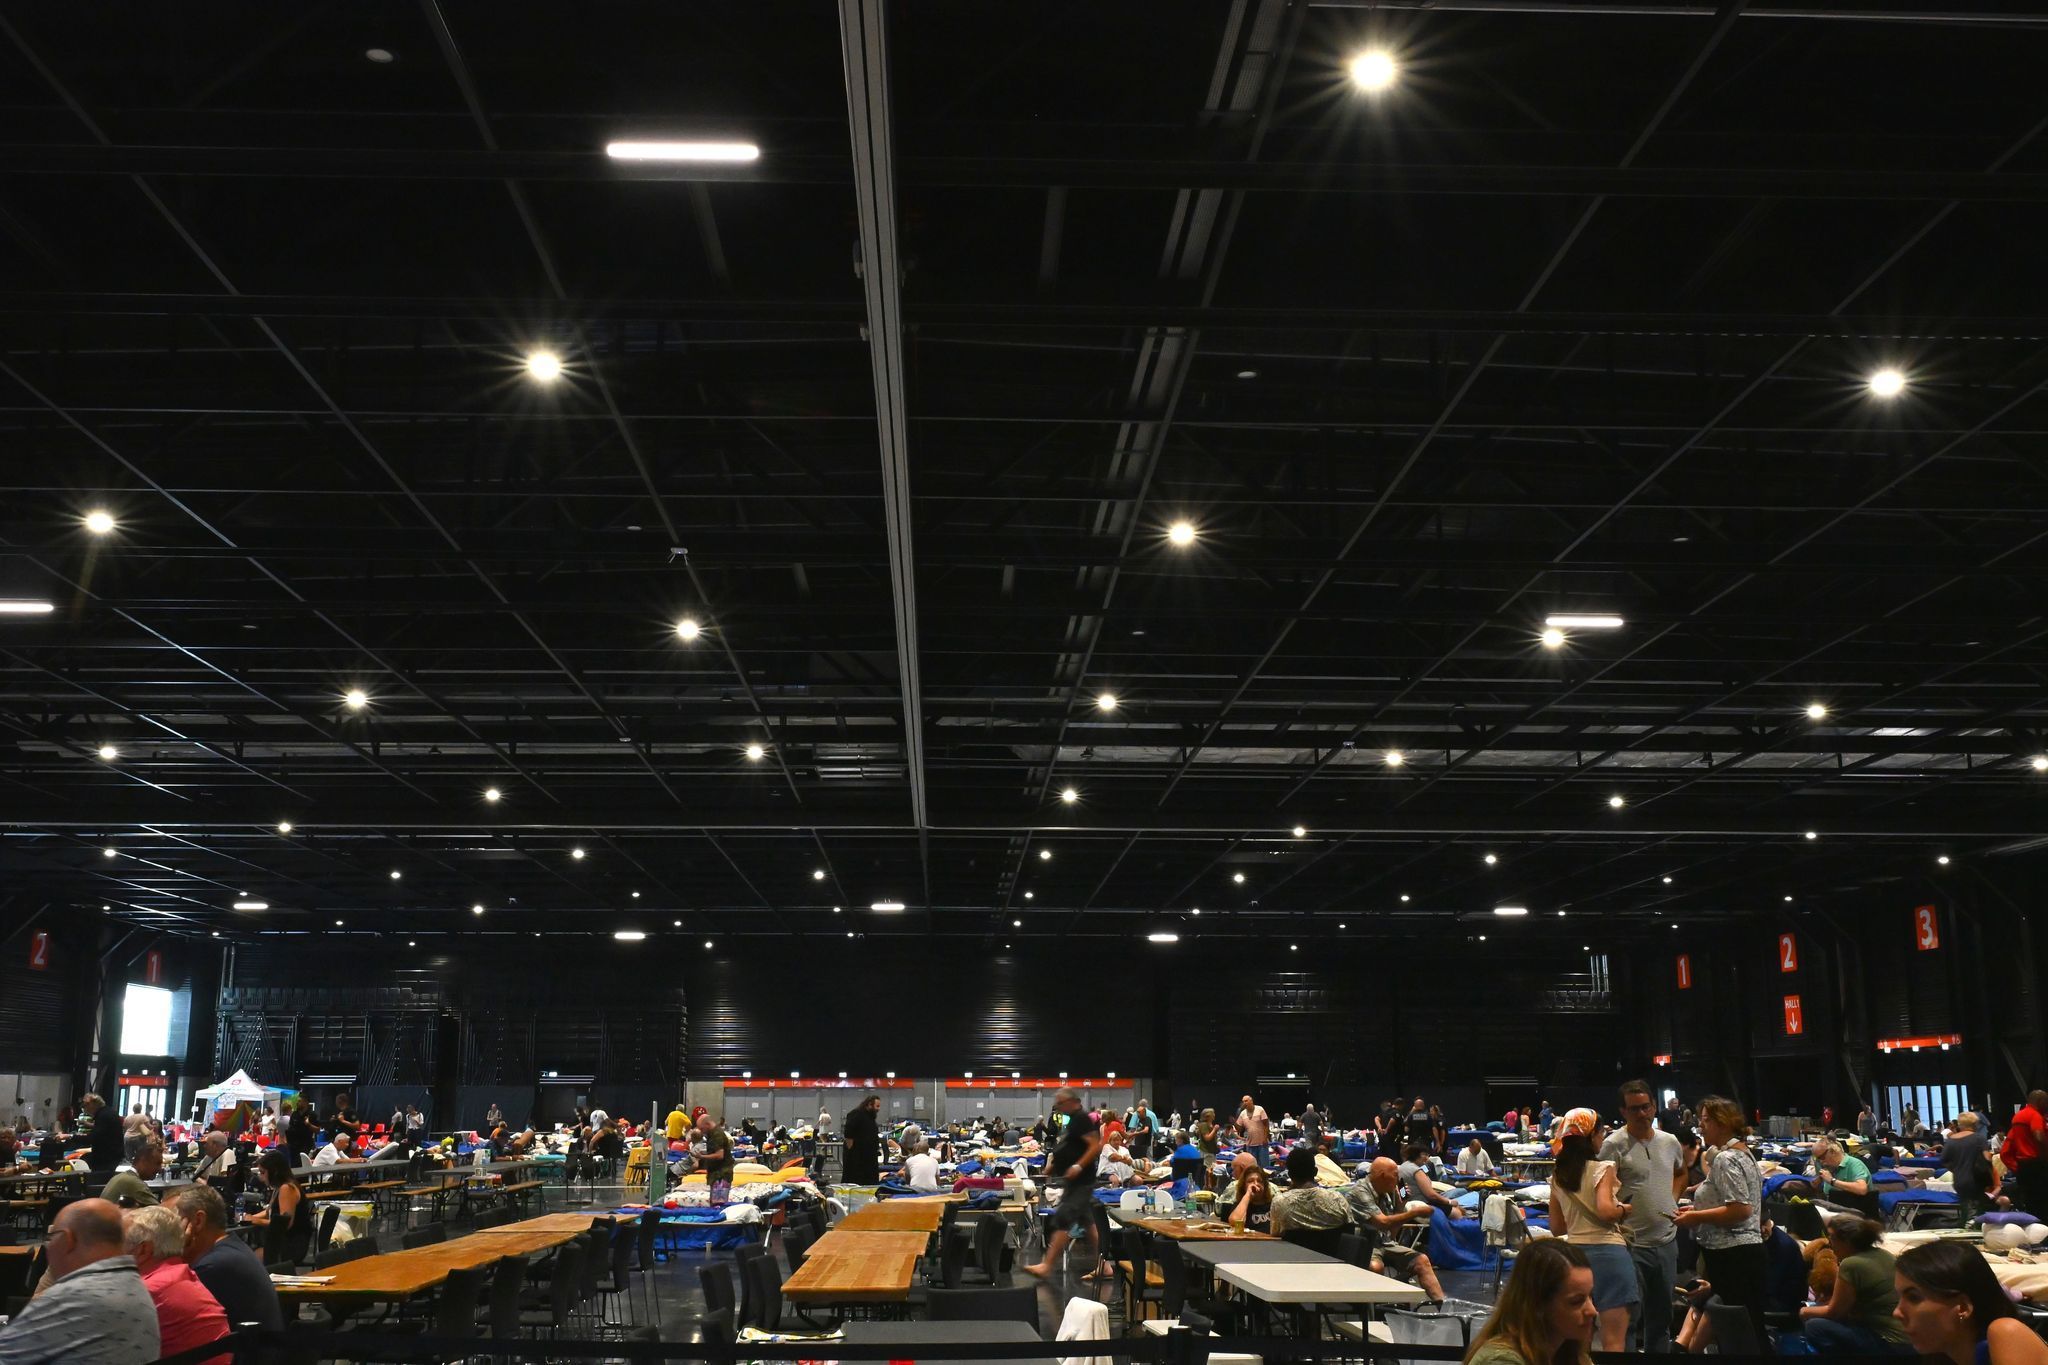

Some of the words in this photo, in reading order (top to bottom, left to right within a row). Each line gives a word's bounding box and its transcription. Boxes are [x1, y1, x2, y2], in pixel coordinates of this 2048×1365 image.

[1920, 909, 1933, 945] 3
[34, 932, 47, 964] 2
[1783, 937, 1793, 968] 2
[151, 954, 158, 982] 1
[1680, 957, 1686, 985] 1
